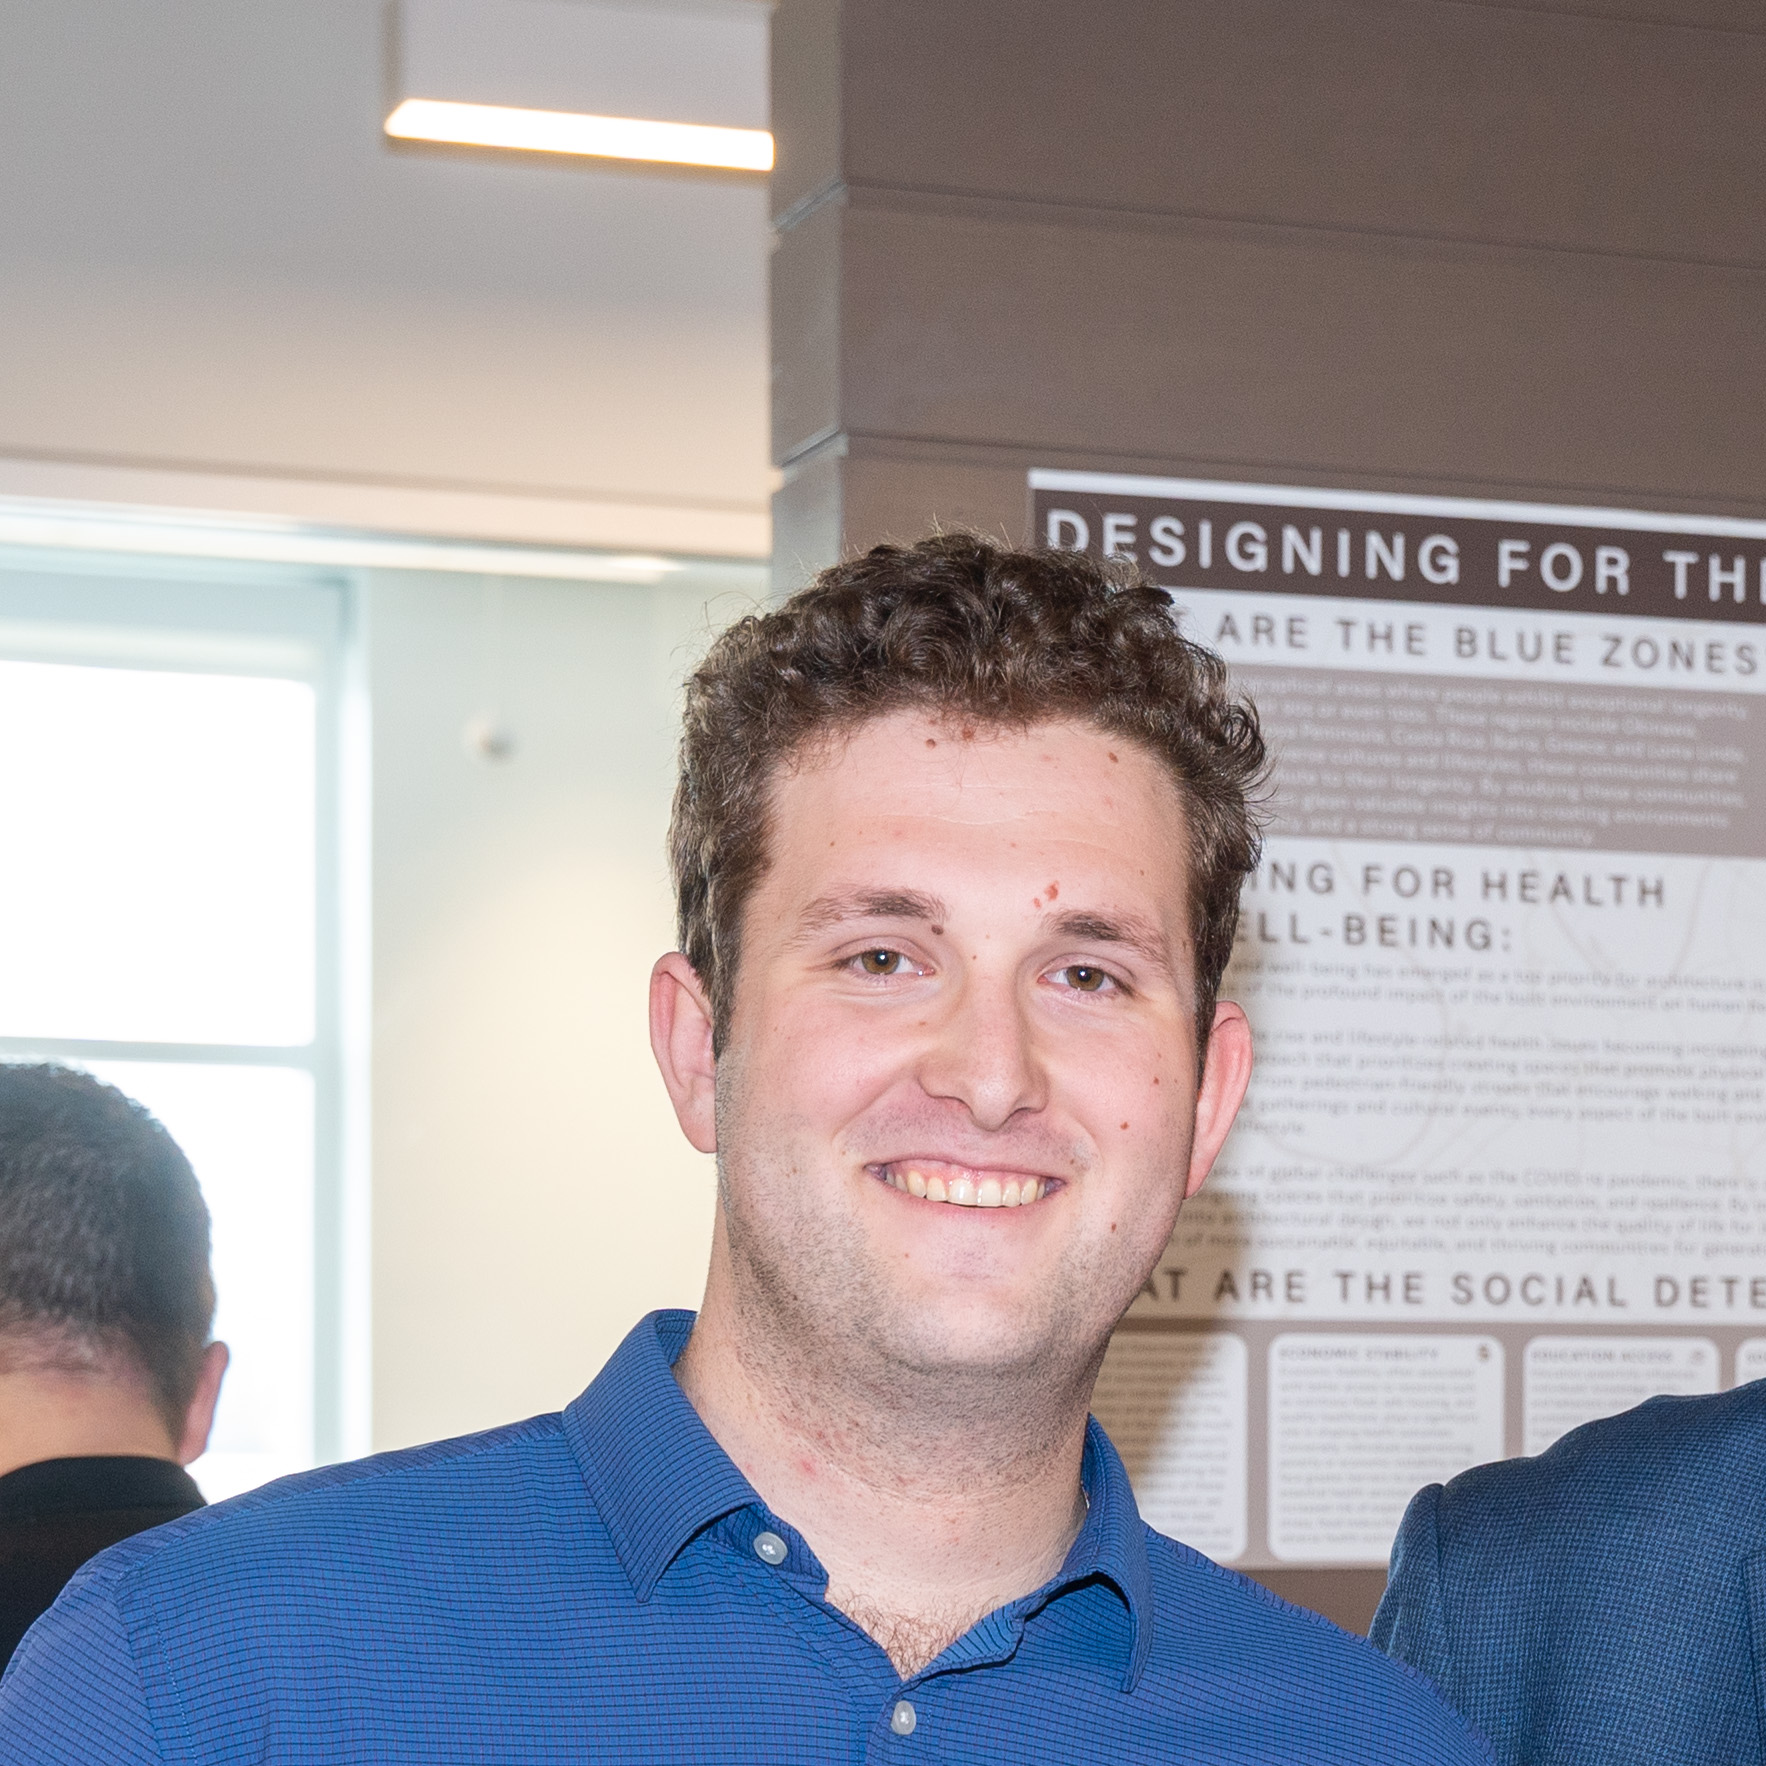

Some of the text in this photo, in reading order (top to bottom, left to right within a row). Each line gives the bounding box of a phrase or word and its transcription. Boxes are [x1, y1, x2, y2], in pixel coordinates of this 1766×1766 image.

[1045, 508, 1461, 586] DESIGNING
[1498, 540, 1631, 596] FOR
[1217, 613, 1308, 650] ARE
[1336, 619, 1428, 656] THE
[1456, 627, 1576, 664] BLUE
[1250, 863, 1666, 907] ING FOR HEALTH
[1236, 909, 1512, 951] ELL-BEING:
[1141, 1269, 1187, 1302] AT
[1215, 1269, 1306, 1303] ARE
[1336, 1270, 1424, 1305] THE
[1450, 1272, 1626, 1308] SOCIAL
